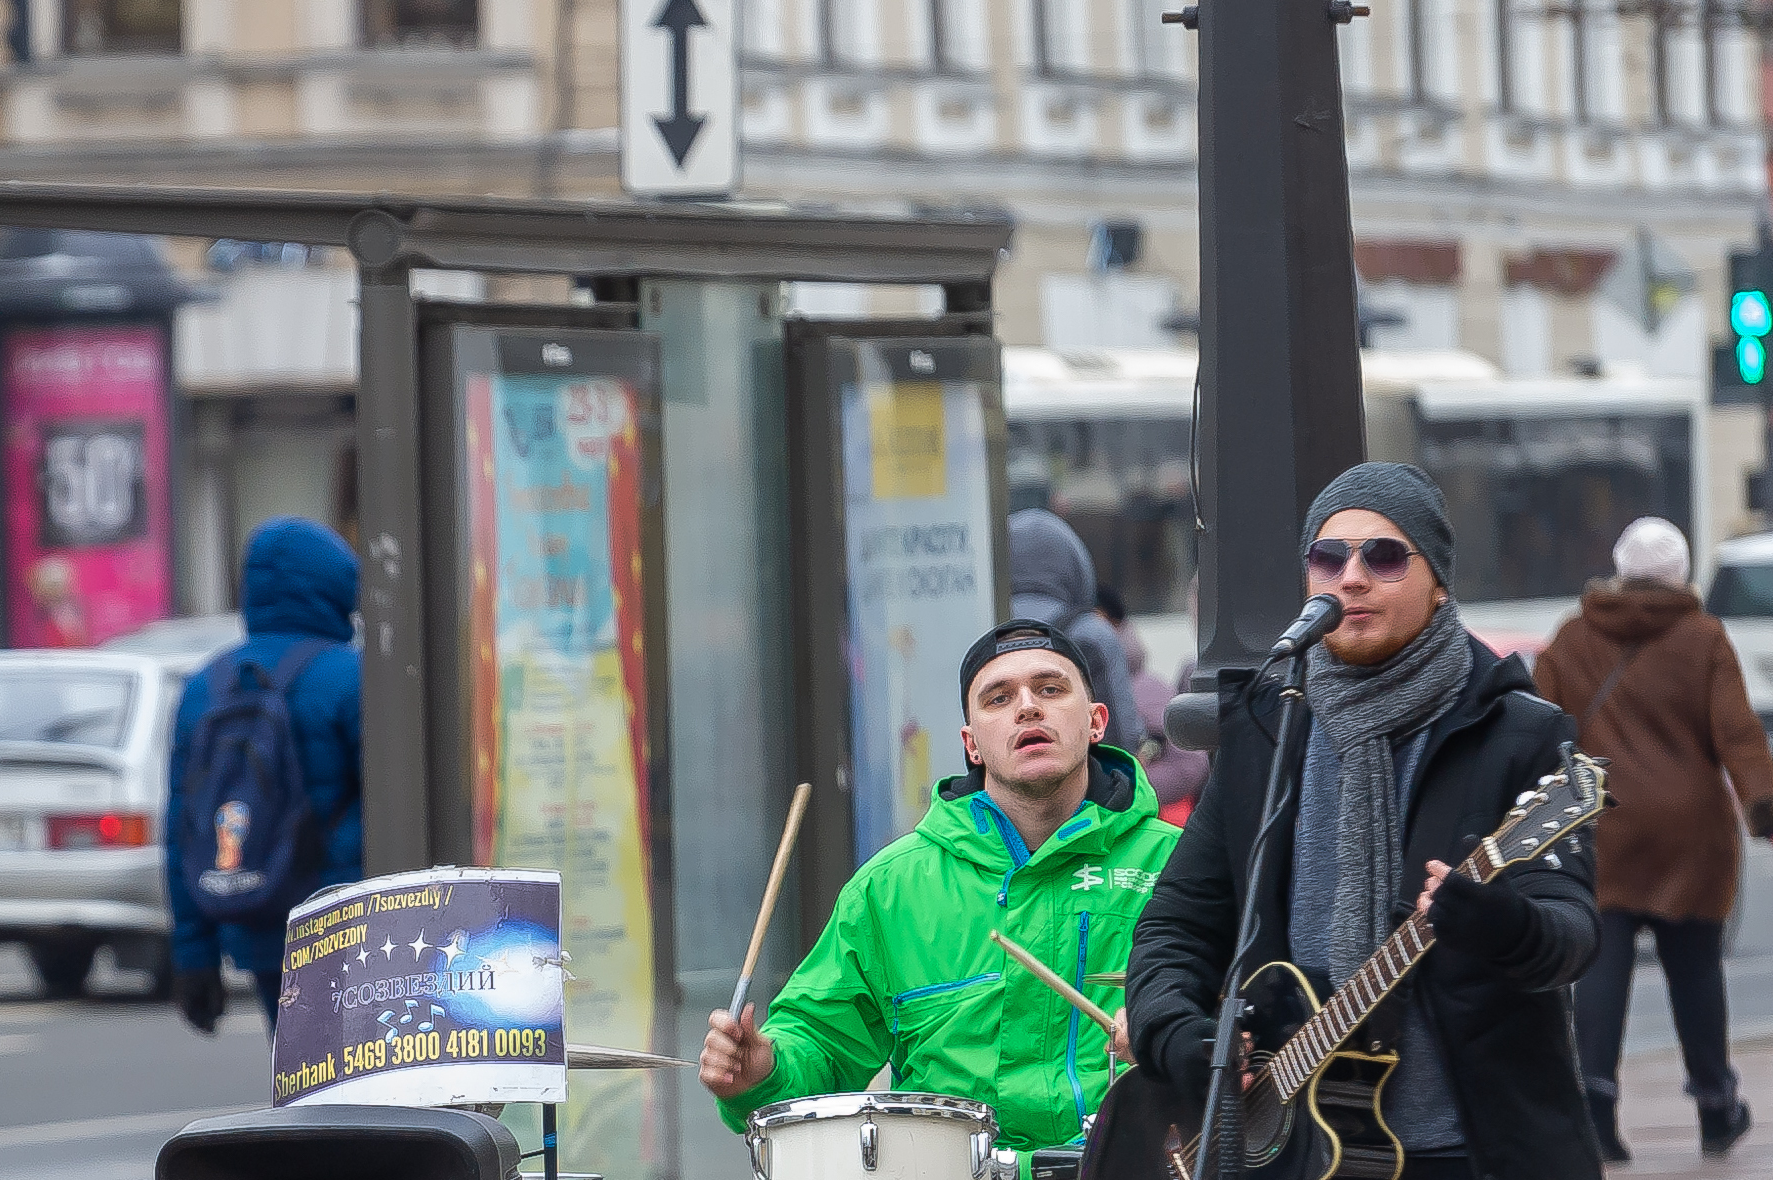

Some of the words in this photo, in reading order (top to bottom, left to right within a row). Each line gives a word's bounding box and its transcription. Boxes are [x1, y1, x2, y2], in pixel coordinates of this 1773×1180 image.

[274, 1052, 336, 1101] Sberbank
[343, 1038, 386, 1075] 5469
[391, 1031, 440, 1065] 3800
[445, 1028, 489, 1058] 4181
[494, 1028, 546, 1057] 0093
